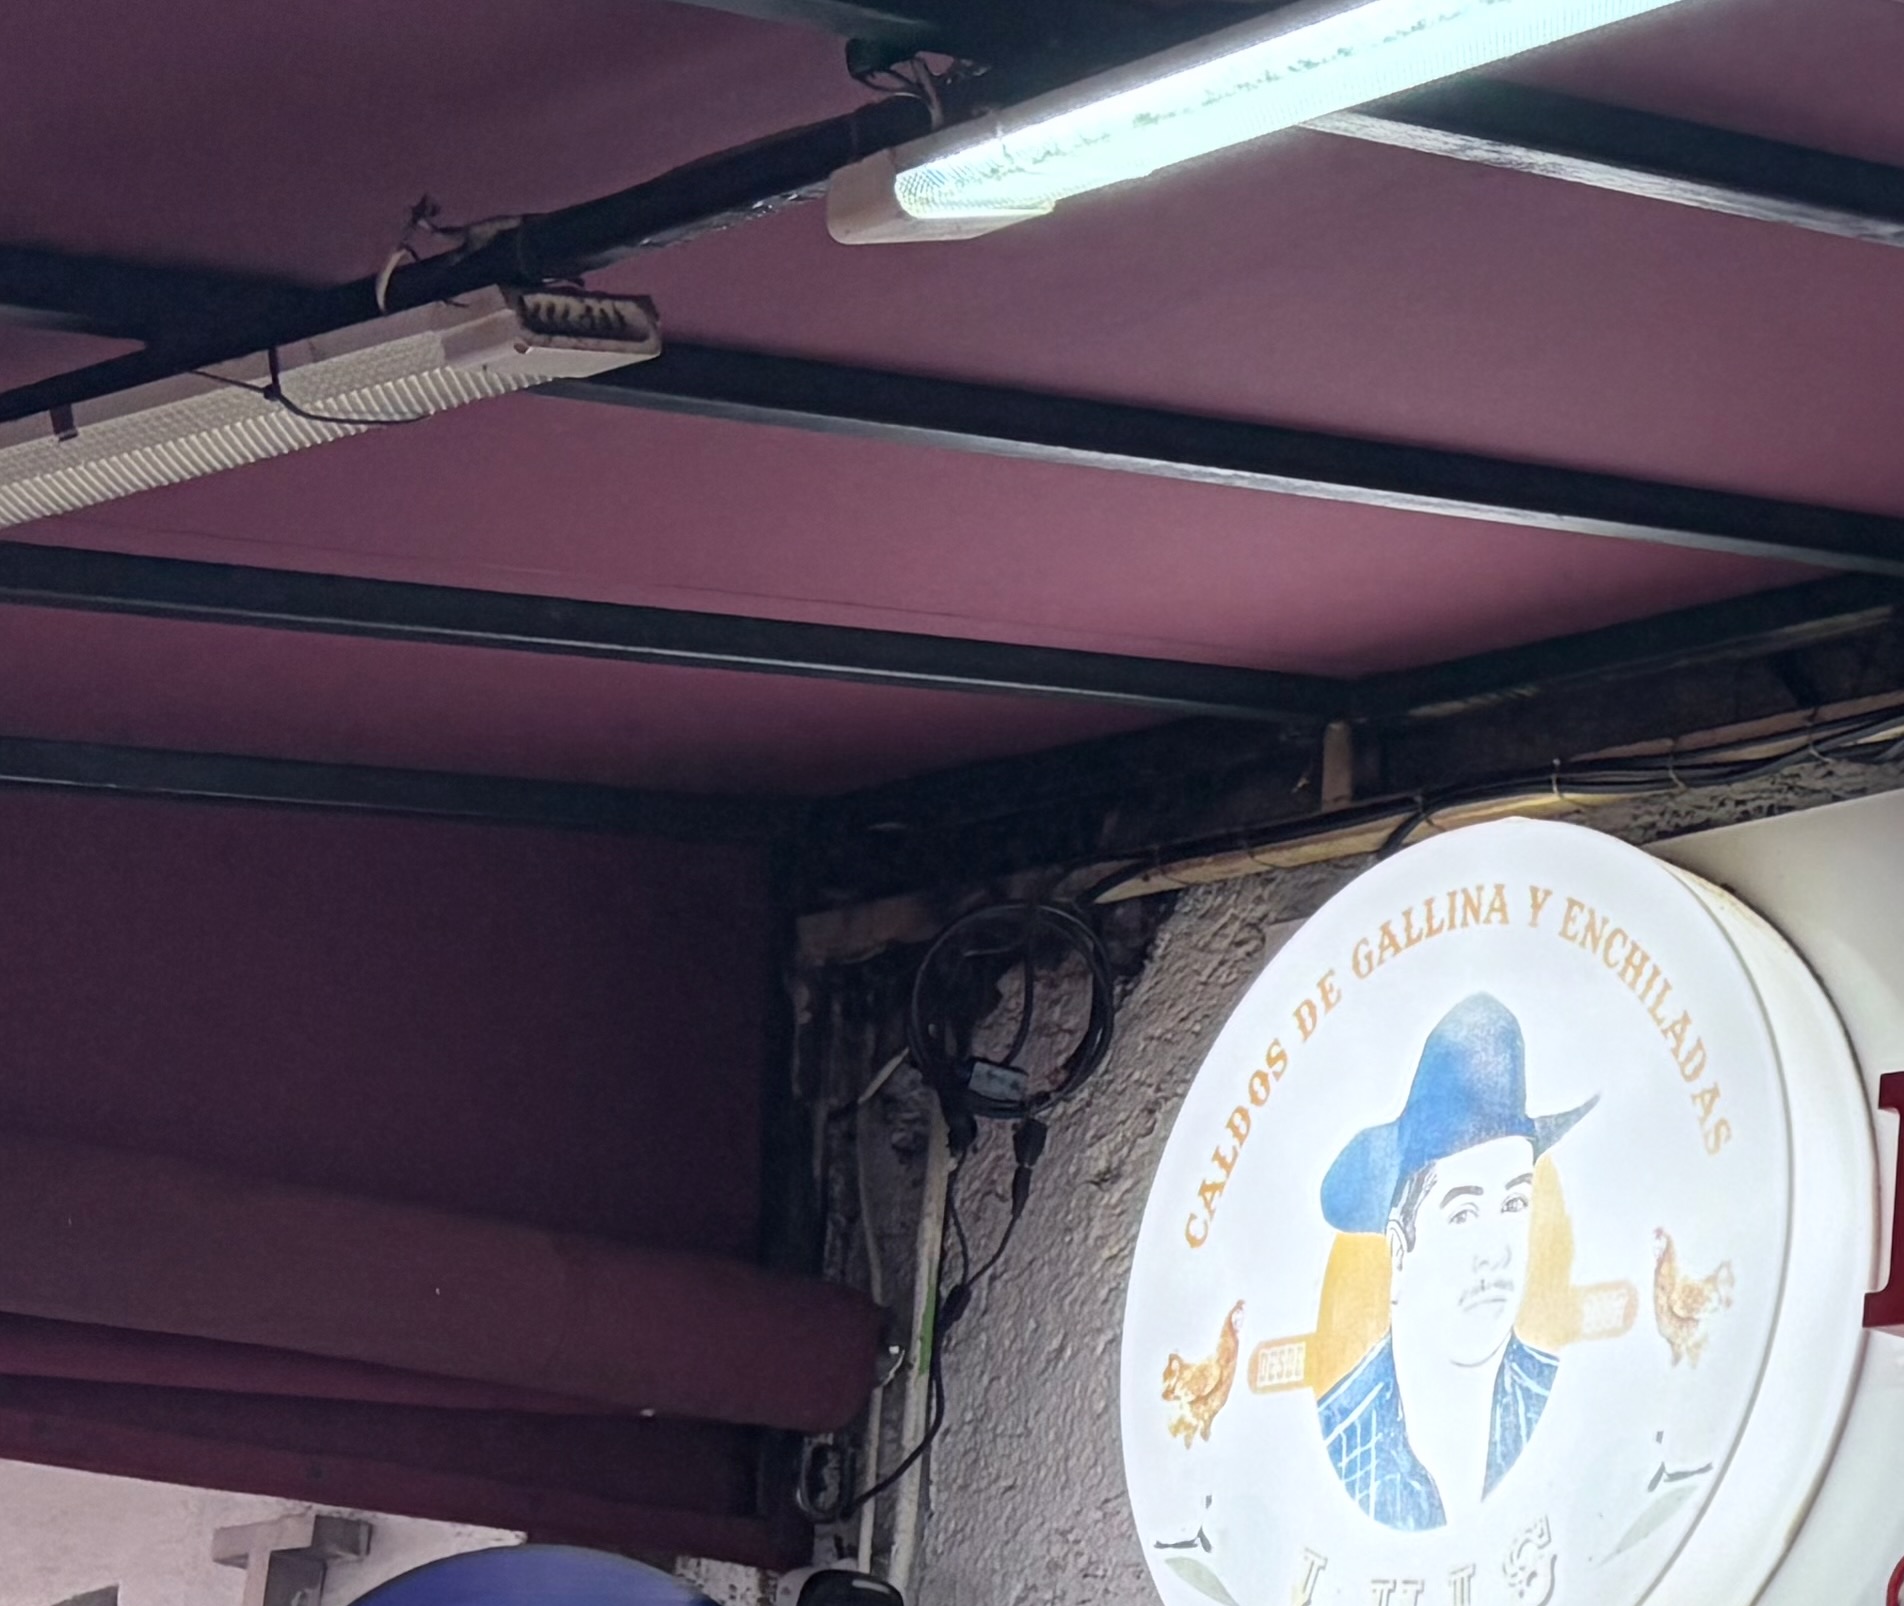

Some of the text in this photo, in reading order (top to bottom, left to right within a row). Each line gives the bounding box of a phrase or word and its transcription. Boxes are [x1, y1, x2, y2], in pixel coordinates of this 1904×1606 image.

[1185, 882, 1734, 1249] CALDOS DE GALLINA Y ENCHILADAS
